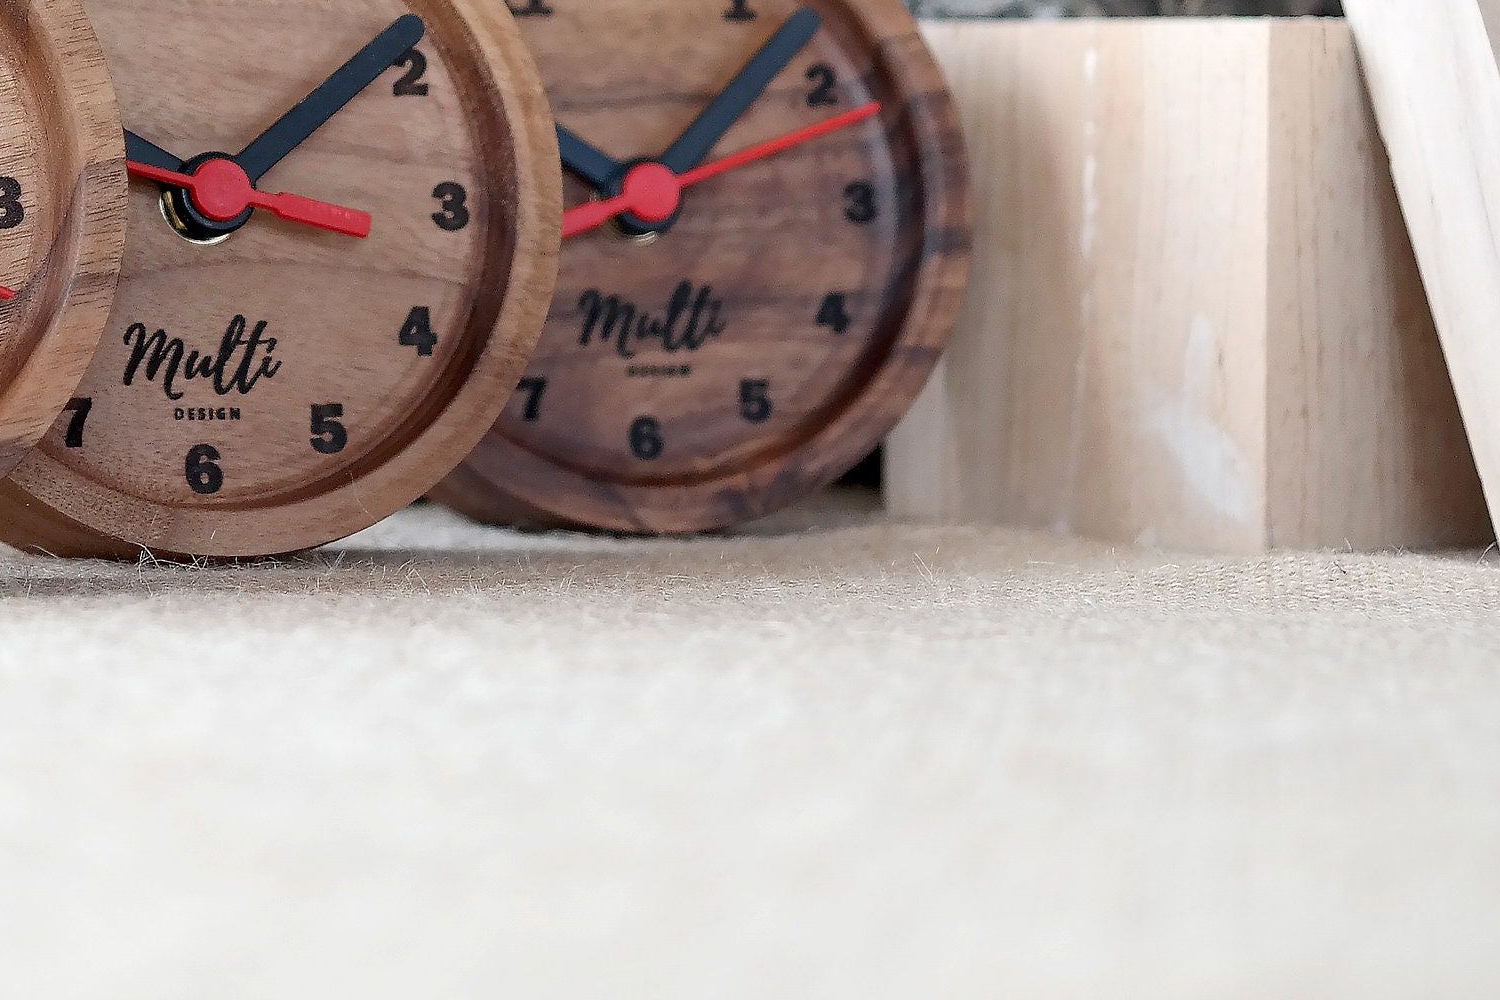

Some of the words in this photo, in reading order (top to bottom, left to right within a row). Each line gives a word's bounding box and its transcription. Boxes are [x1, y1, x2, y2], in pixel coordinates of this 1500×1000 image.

[393, 48, 428, 96] 2
[806, 64, 838, 107] 2
[432, 182, 470, 231] 3
[844, 181, 876, 225] 3
[399, 306, 437, 356] 4
[816, 293, 852, 335] 4
[123, 314, 281, 400] Multi
[175, 407, 241, 421] DESIGN
[515, 377, 547, 420] 7
[740, 380, 772, 424] 5
[63, 397, 92, 447] 7
[310, 404, 347, 454] 5
[629, 417, 664, 460] 6
[185, 444, 223, 494] 6
